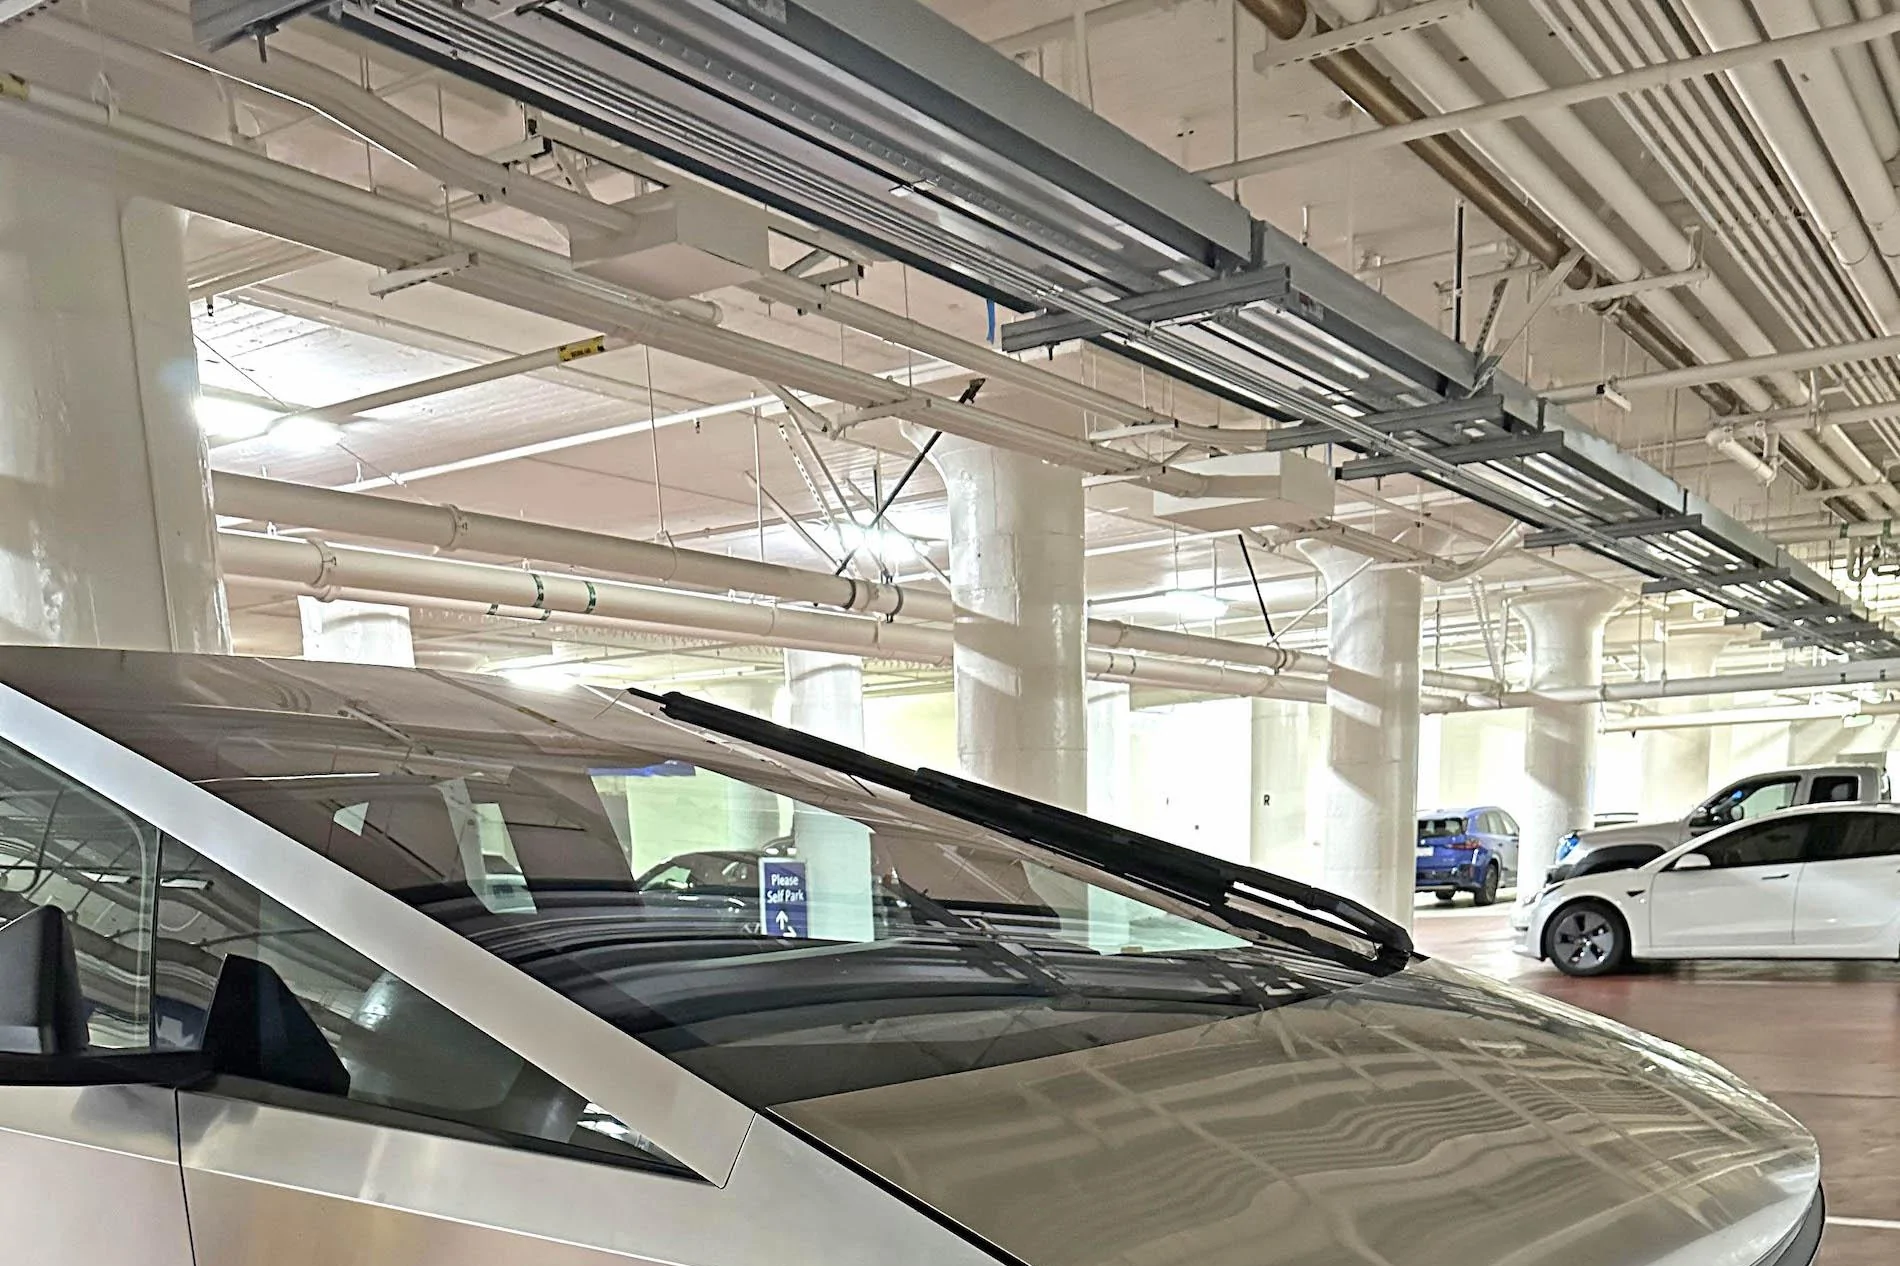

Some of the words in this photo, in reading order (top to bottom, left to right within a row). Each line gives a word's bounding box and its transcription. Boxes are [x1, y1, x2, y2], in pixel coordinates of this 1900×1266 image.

[1263, 794, 1270, 806] R
[771, 874, 799, 886] Please
[767, 889, 784, 903] Self
[785, 889, 804, 902] Park
